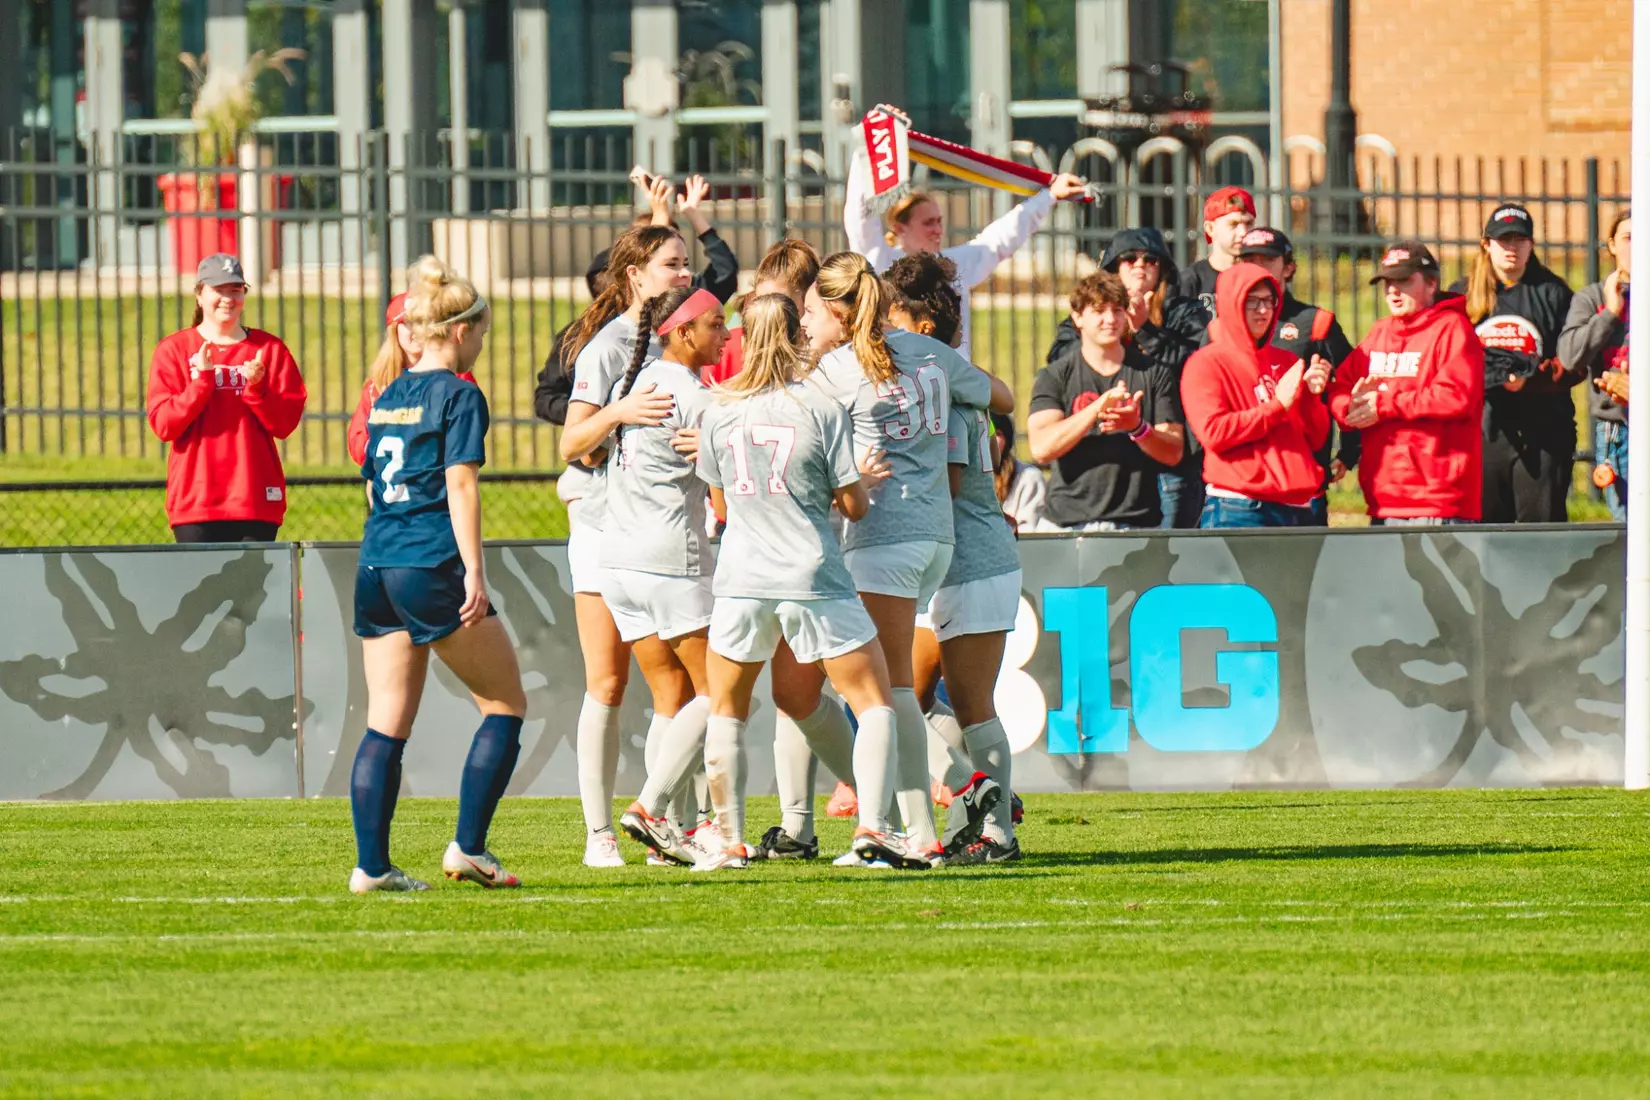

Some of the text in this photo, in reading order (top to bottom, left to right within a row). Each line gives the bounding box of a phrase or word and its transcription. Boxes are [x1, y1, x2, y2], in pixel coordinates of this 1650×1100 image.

[871, 127, 895, 181] PLAY
[876, 362, 949, 441] 30
[375, 435, 411, 504] 2
[727, 423, 796, 496] 17
